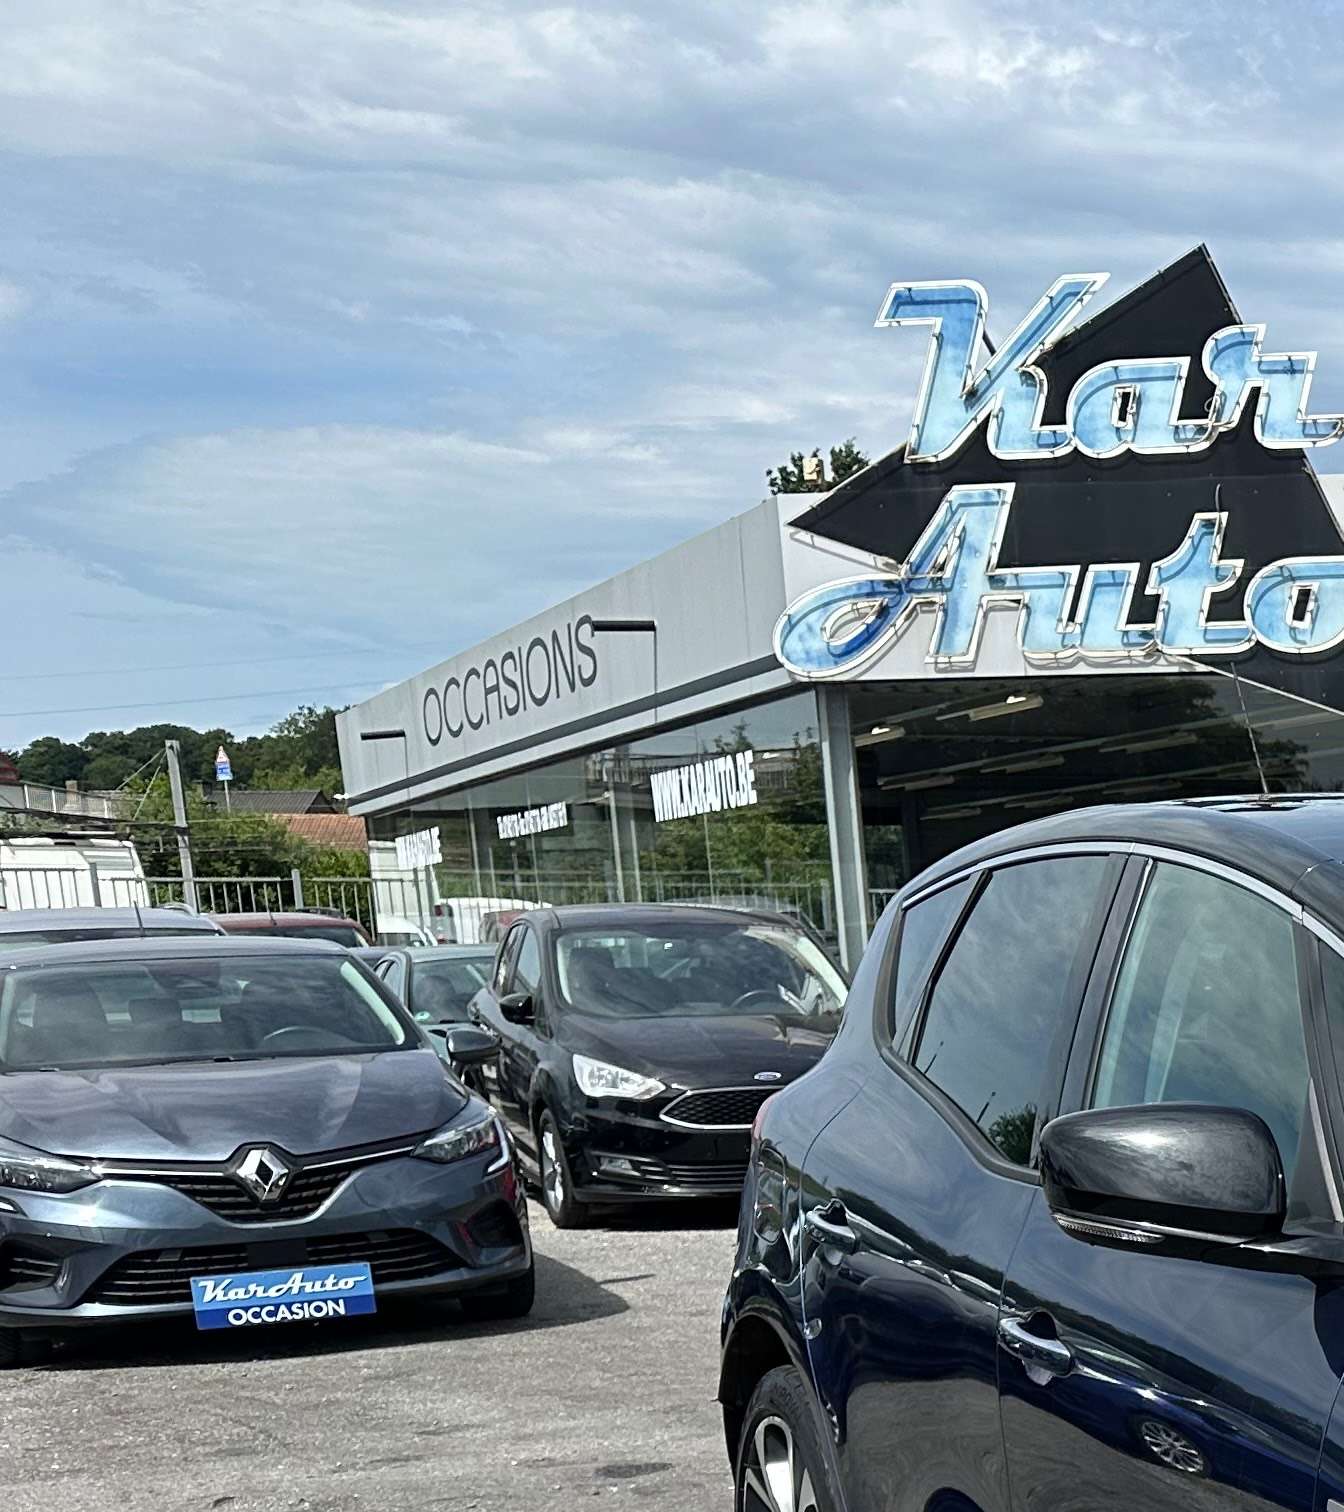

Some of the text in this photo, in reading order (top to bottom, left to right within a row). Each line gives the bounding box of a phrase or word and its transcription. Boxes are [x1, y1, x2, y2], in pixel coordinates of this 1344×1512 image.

[422, 613, 598, 747] OCCASIONS
[649, 749, 758, 823] WWW.KARAUTO.BE
[227, 1298, 346, 1327] OCCASION
